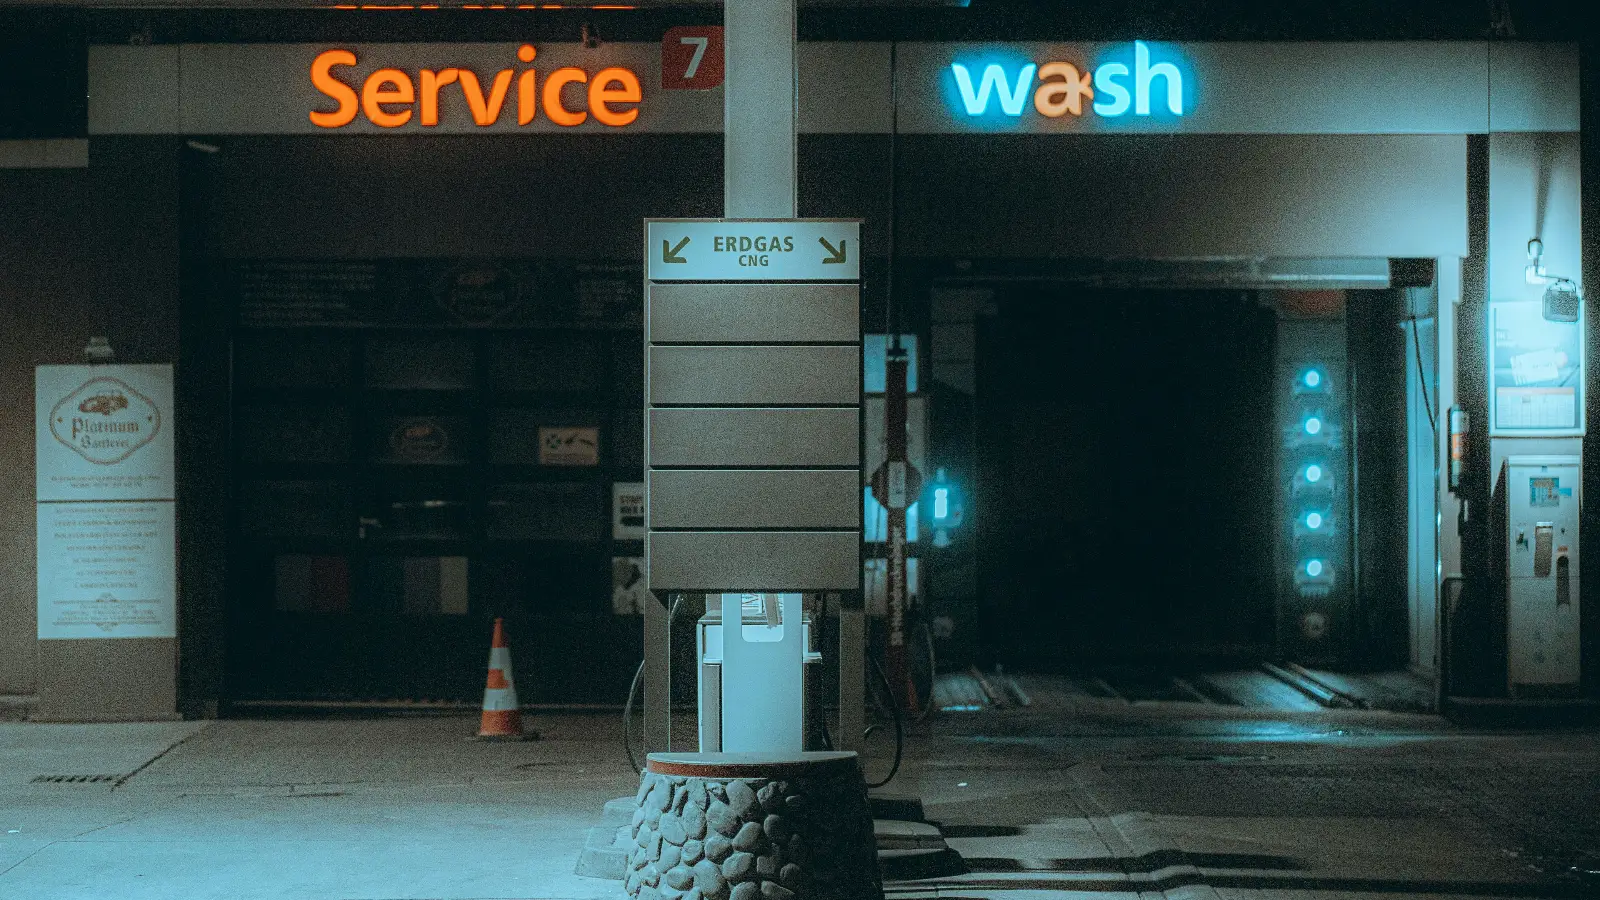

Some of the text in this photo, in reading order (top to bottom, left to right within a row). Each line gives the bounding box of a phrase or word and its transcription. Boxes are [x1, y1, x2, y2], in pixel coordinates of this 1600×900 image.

[680, 37, 709, 79] 7
[309, 44, 642, 128] Service
[951, 39, 1183, 118] wash
[713, 236, 794, 252] ERDGAS
[738, 254, 769, 267] CNG
[72, 417, 140, 439] Platinum
